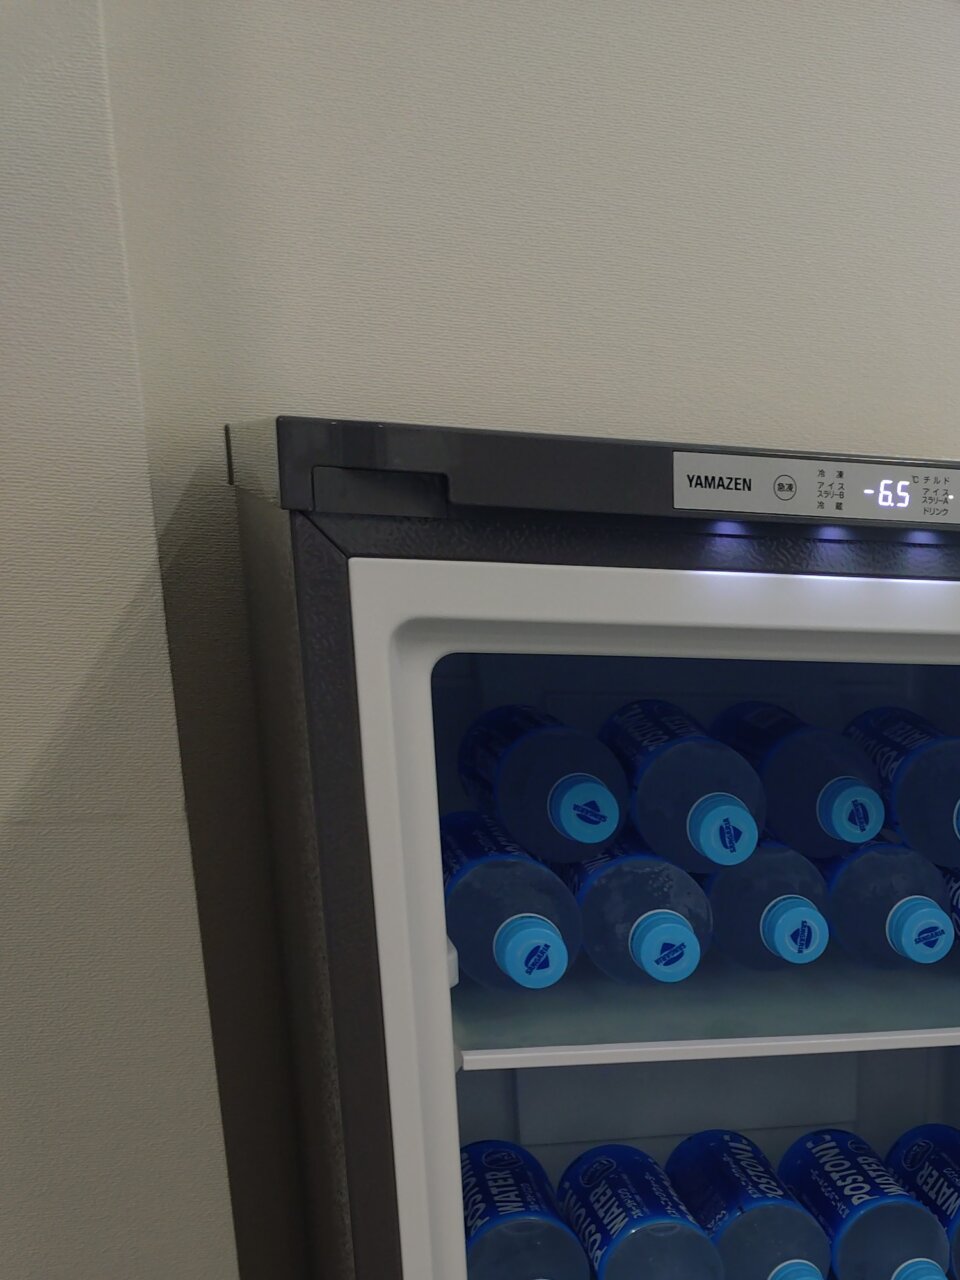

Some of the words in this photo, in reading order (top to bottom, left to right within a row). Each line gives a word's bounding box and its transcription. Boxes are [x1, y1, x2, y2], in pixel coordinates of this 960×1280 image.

[687, 474, 752, 492] YAMAZEN
[817, 482, 844, 491] アイス
[923, 475, 950, 485] チルド
[923, 507, 949, 516] ドリンク
[485, 1169, 526, 1216] WATER
[589, 1179, 629, 1236] WATER
